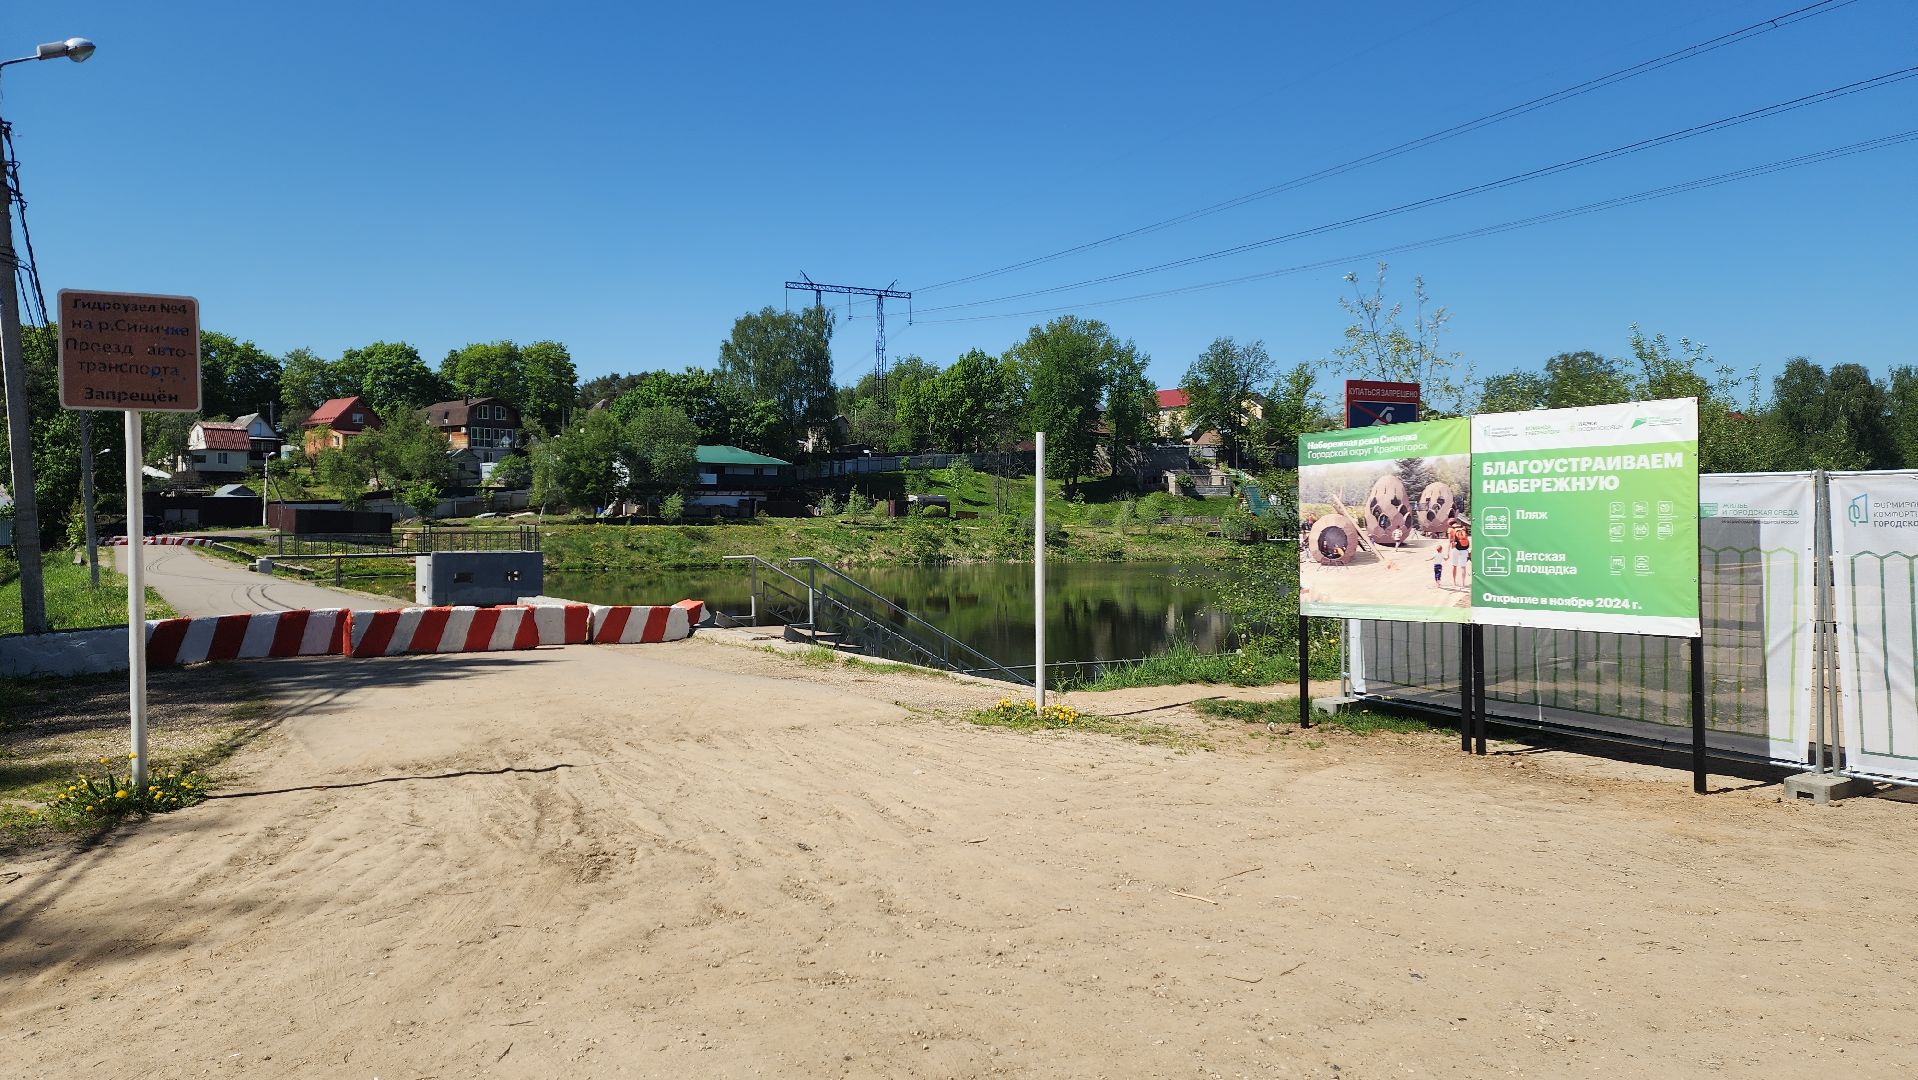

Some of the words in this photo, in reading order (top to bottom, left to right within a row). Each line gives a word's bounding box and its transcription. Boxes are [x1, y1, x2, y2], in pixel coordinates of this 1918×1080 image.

[72, 298, 156, 314] Гидроузел
[160, 303, 187, 315] №4
[72, 319, 94, 330] на
[65, 338, 133, 356] Проезд
[147, 344, 194, 357] авто-
[79, 361, 180, 376] транспорта
[84, 387, 178, 405] Запрещён
[1348, 388, 1380, 396] КУПАТЬСЯ
[1381, 389, 1418, 398] ЗАПРЕЩЕНО
[1307, 439, 1358, 449] Набережная
[1358, 437, 1379, 446] реки
[1308, 448, 1348, 459] Городской
[1349, 447, 1372, 457] округ
[1374, 443, 1428, 454] Красногорск
[1482, 452, 1683, 476] БЛАГОУСТРАИВАЕМ
[1482, 475, 1620, 494] НАБЕРЕЖНУЮ
[1516, 509, 1548, 520] Пляж
[1516, 550, 1566, 562] Детская
[1516, 564, 1577, 575] площадка
[1483, 592, 1539, 604] Открытие
[1549, 597, 1594, 608] ноябре
[1595, 597, 1630, 609] 2024
[1632, 601, 1643, 610] г.
